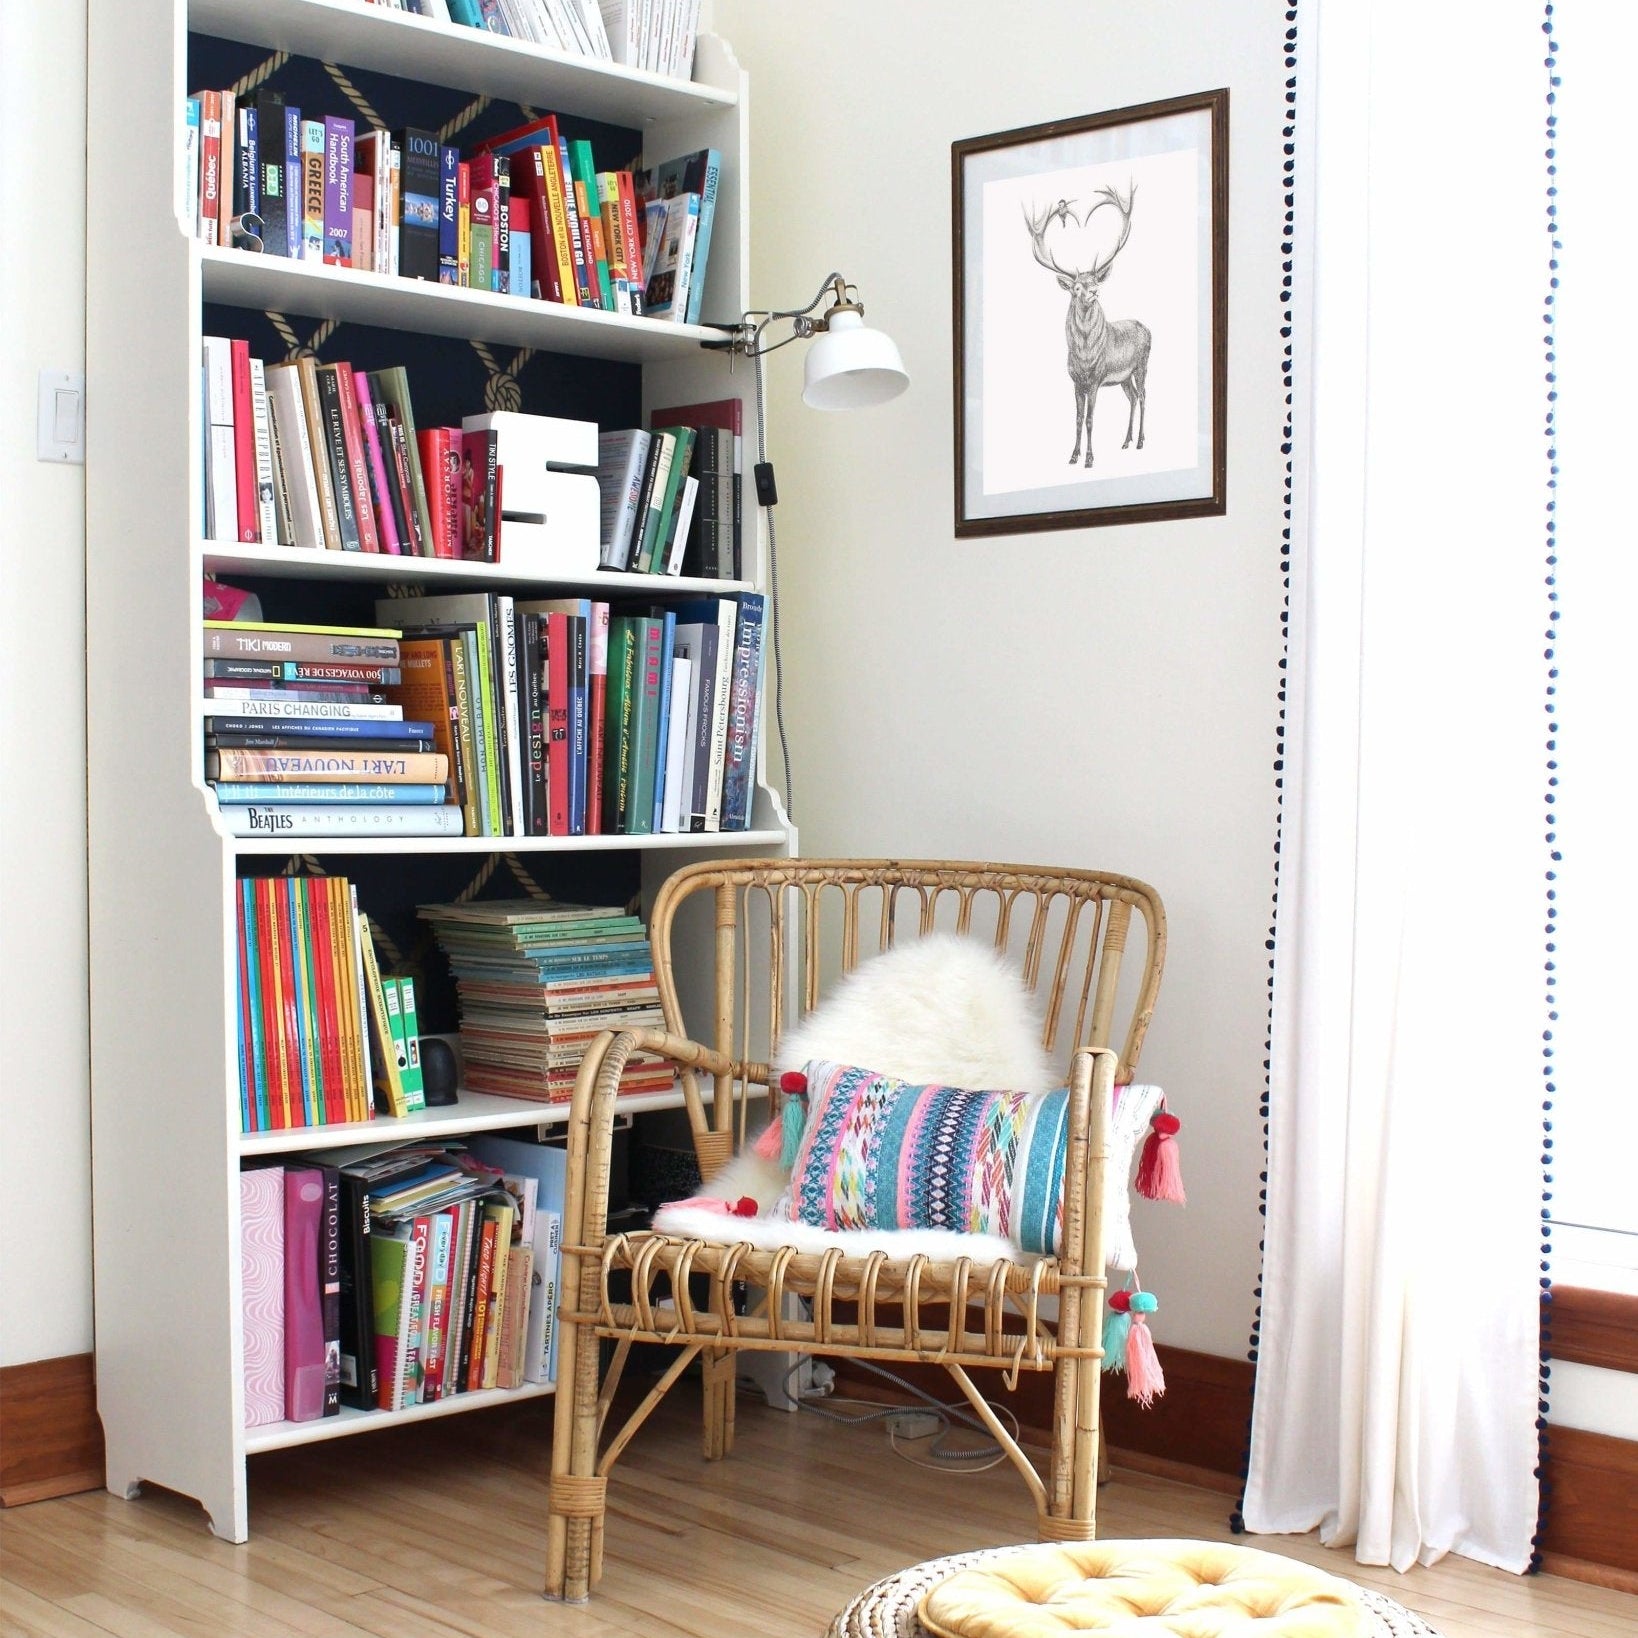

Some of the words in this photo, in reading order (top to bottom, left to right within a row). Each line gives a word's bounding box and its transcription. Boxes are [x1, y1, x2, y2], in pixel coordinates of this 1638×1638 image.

[311, 135, 321, 144] GO
[341, 134, 350, 164] South
[408, 136, 438, 157] 1001
[248, 139, 257, 173] Belgium
[329, 133, 339, 185] Handbook
[205, 155, 217, 200] Québec
[545, 150, 559, 193] ANGLETERRE
[705, 165, 719, 204] ESSENTIAL
[308, 158, 322, 214] GREECE
[339, 165, 350, 213] American
[445, 177, 457, 223] Turkey
[551, 192, 564, 225] NOUVELLE
[611, 202, 619, 221] NEW
[328, 227, 348, 238] 2007
[500, 205, 509, 252] BOSTON
[614, 222, 622, 244] YORK
[626, 218, 634, 236] CITY
[559, 240, 570, 267] BOSTON
[575, 249, 585, 265] GO
[585, 233, 594, 264] ENGLAND
[615, 245, 625, 264] CITY
[628, 236, 636, 257] YORK
[631, 258, 639, 280] NEW
[684, 253, 692, 270] York
[682, 271, 690, 289] New
[330, 408, 339, 420] LE
[256, 428, 272, 480] HEPBURN
[268, 395, 279, 438] Communication
[275, 446, 288, 493] épanouissement
[283, 493, 293, 522] personnel
[336, 446, 345, 457] ET
[488, 443, 497, 457] TIKI
[337, 458, 347, 474] SES
[443, 446, 452, 505] D'ORSAY
[487, 457, 497, 481] STYLE
[354, 458, 368, 502] Japonais
[339, 474, 353, 520] SYMBOLES
[360, 503, 370, 520] Les
[236, 638, 262, 652] TIKI
[262, 640, 292, 652] MODERN
[505, 607, 516, 666] GNOMES
[311, 667, 324, 678] DE
[324, 668, 365, 680] VOYAGES
[455, 646, 465, 676] L'ART
[623, 646, 635, 689] Fabuleux
[646, 627, 661, 698] miami
[365, 669, 382, 680] 500
[508, 669, 518, 694] LES
[532, 697, 538, 707] au
[702, 678, 711, 712] FAMOUS
[733, 620, 756, 763] Impressionism
[241, 701, 281, 715] PARIS
[283, 704, 351, 718] CHANGING
[458, 679, 471, 743] NOUVEAU
[621, 691, 633, 726] Album
[714, 673, 728, 767] Saint-Pétersbourg
[577, 718, 583, 727] AU
[700, 712, 708, 748] FROCKS
[528, 709, 542, 771] design
[265, 757, 356, 773] NOUVEAU
[363, 759, 406, 775] L'ART
[534, 773, 541, 783] Le
[277, 786, 337, 798] Intérieurs
[339, 787, 353, 798] de
[354, 787, 367, 798] la
[368, 786, 395, 799] côte
[247, 807, 294, 833] BEATLES
[301, 815, 406, 824] ANTHOLOGY
[362, 924, 369, 933] 5
[362, 1193, 370, 1235] Biscuits
[328, 1182, 339, 1276] CHOCOLAT
[438, 1230, 447, 1269] everyday
[482, 1236, 493, 1260] TACO
[478, 1261, 491, 1297] NIGHT!
[433, 1289, 443, 1315] FRESH
[477, 1300, 487, 1318] 101
[430, 1315, 441, 1347] FLAVOR
[543, 1316, 552, 1355] TARTINES
[428, 1348, 438, 1370] FAST
